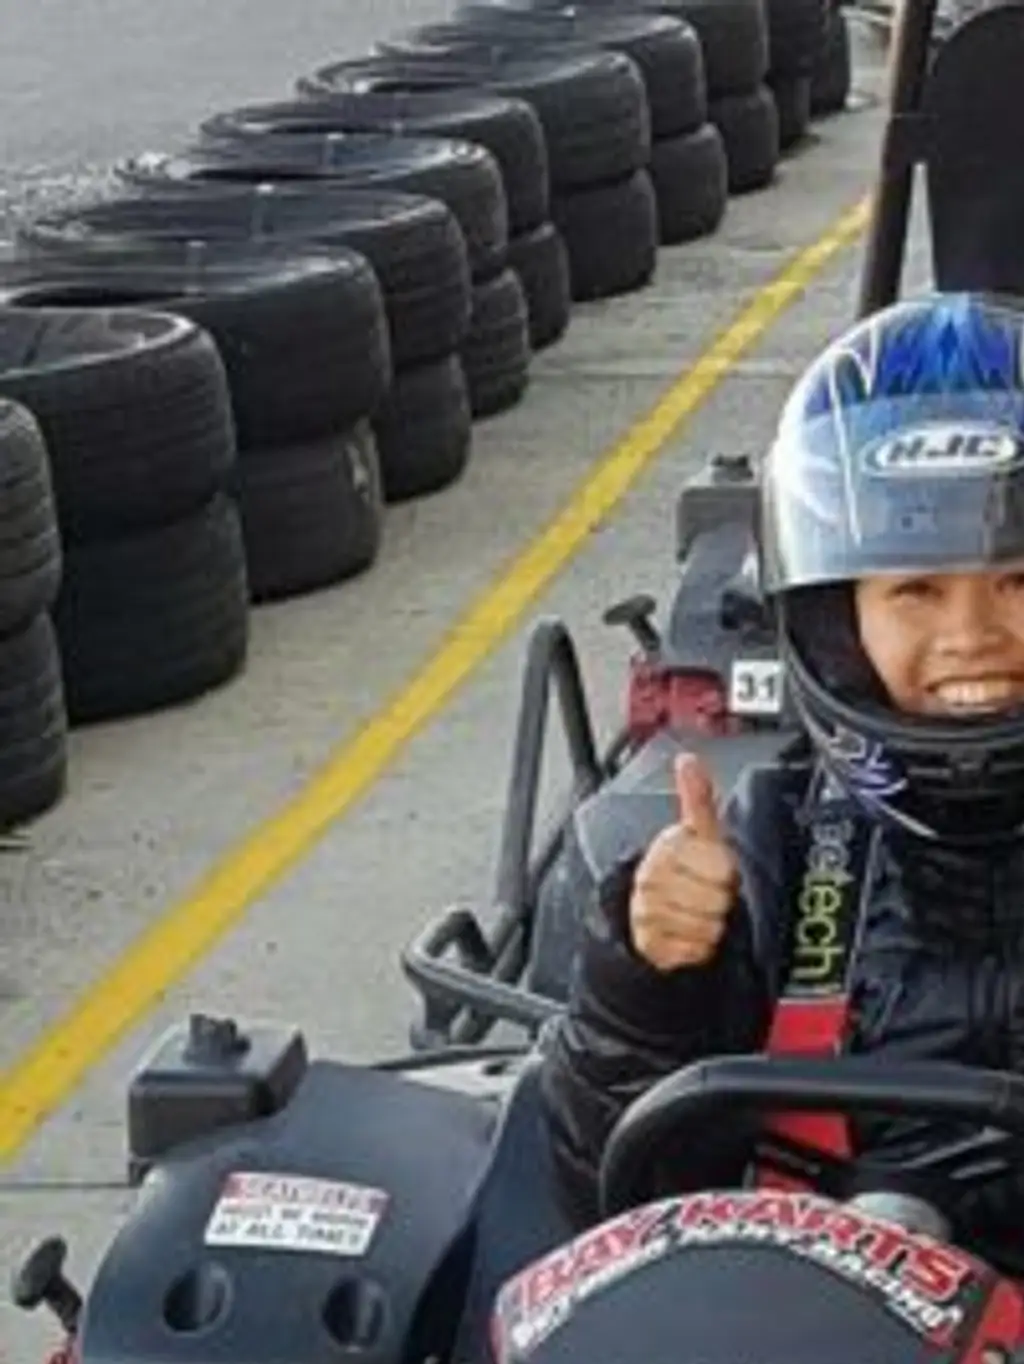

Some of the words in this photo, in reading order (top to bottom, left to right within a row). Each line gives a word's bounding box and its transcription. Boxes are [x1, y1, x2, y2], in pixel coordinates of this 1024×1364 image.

[886, 431, 1008, 464] HJC
[737, 671, 776, 702] 31
[676, 1190, 975, 1301] KARTS
